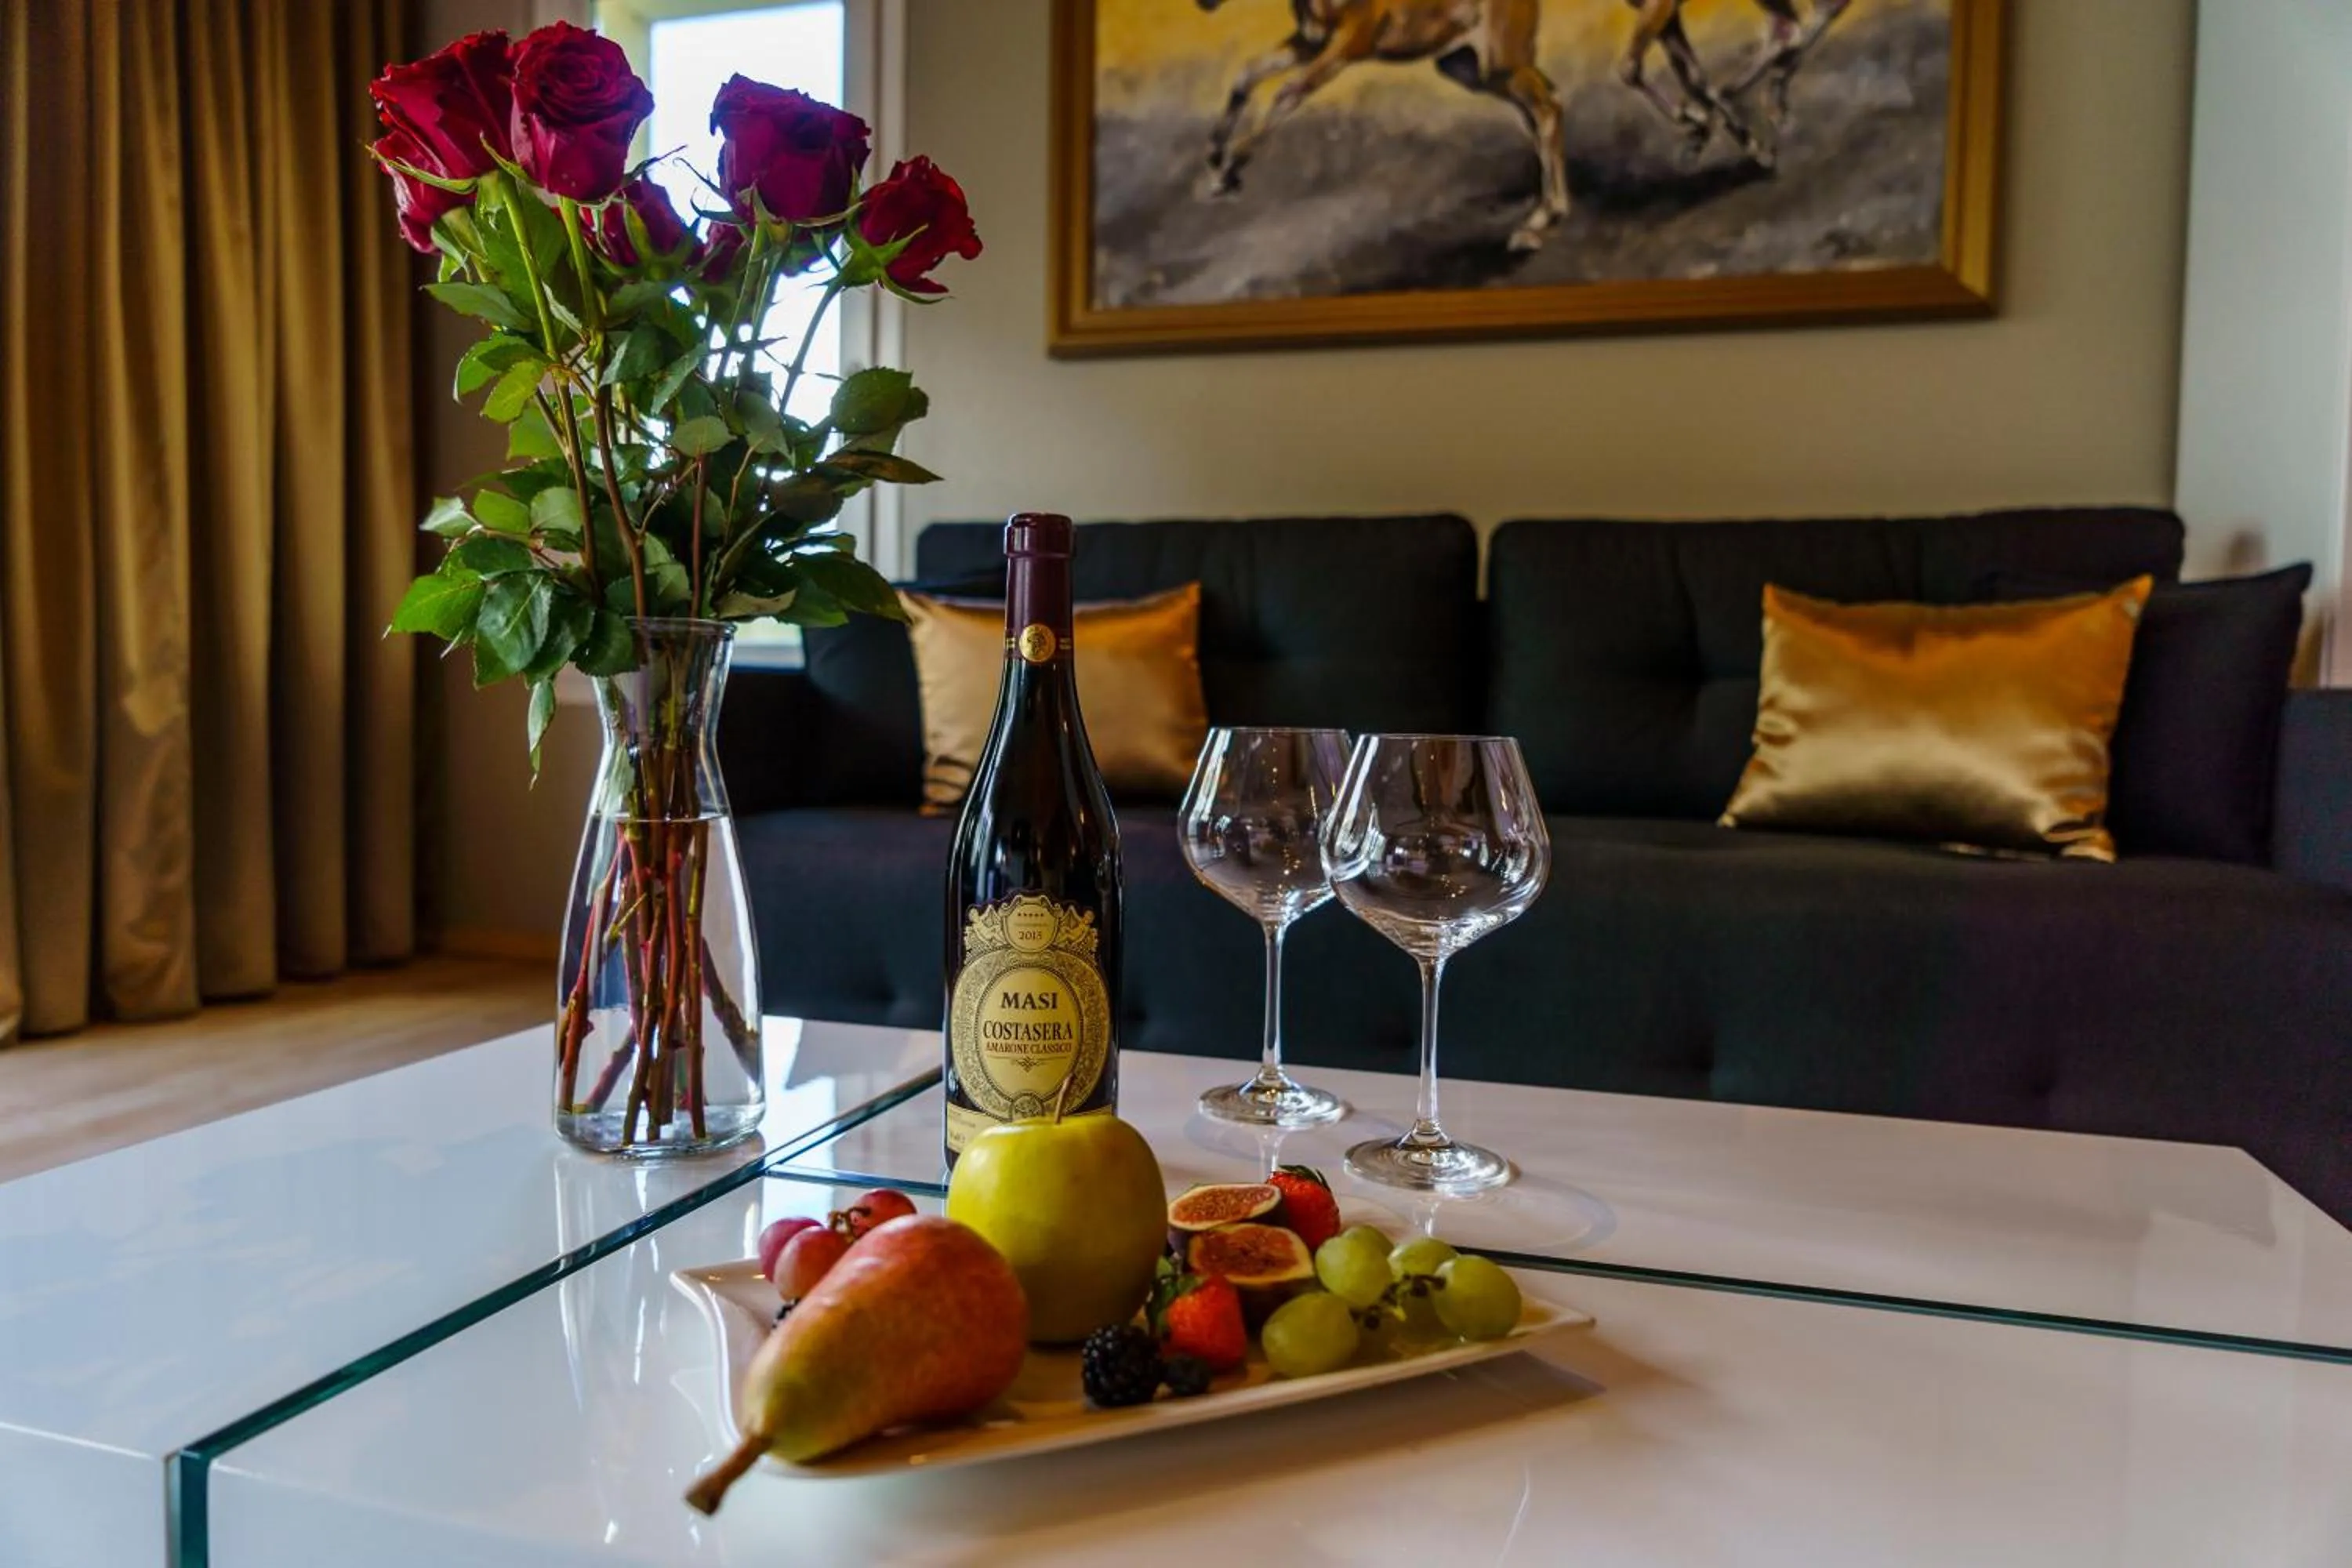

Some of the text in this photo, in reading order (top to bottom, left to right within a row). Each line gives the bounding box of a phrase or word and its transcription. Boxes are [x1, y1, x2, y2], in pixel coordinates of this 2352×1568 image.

[1001, 992, 1058, 1010] MASI
[983, 1020, 1073, 1041] COSTASERA
[1030, 1043, 1072, 1054] CLASSICO
